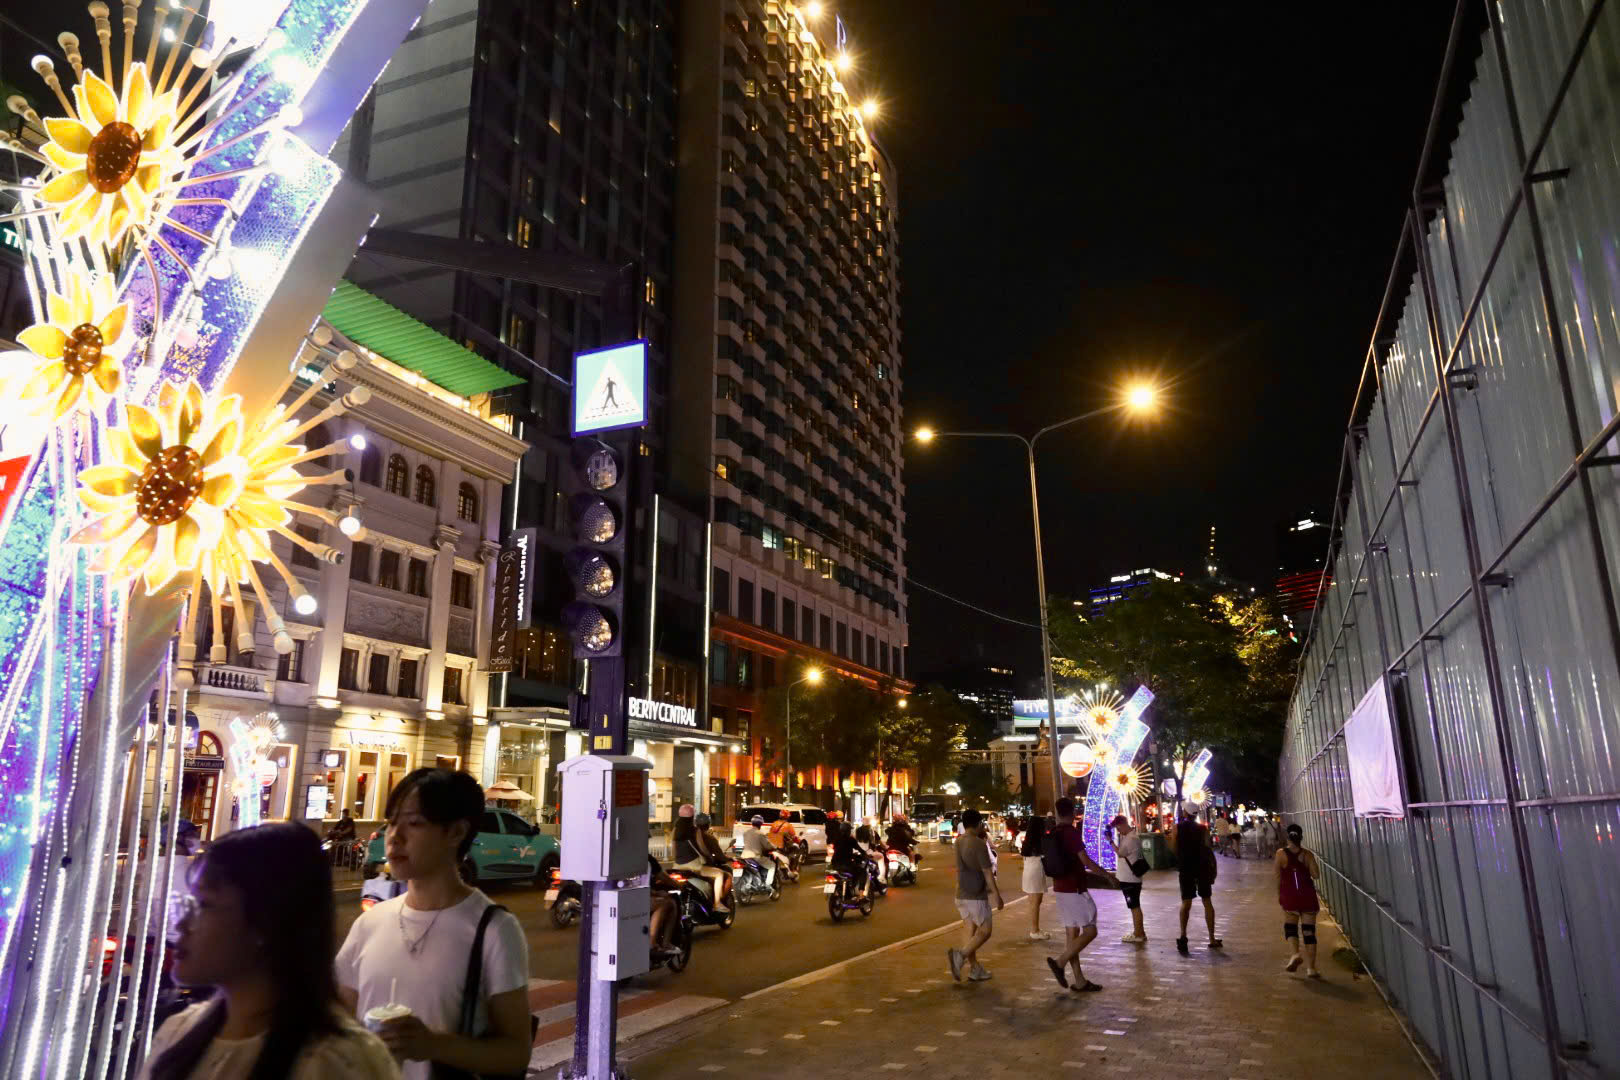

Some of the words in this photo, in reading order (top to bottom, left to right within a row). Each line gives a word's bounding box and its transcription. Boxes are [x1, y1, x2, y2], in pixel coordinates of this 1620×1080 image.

[498, 550, 516, 653] Riverside
[659, 703, 697, 726] CENTRAL
[1024, 702, 1081, 714] HYOUNG
